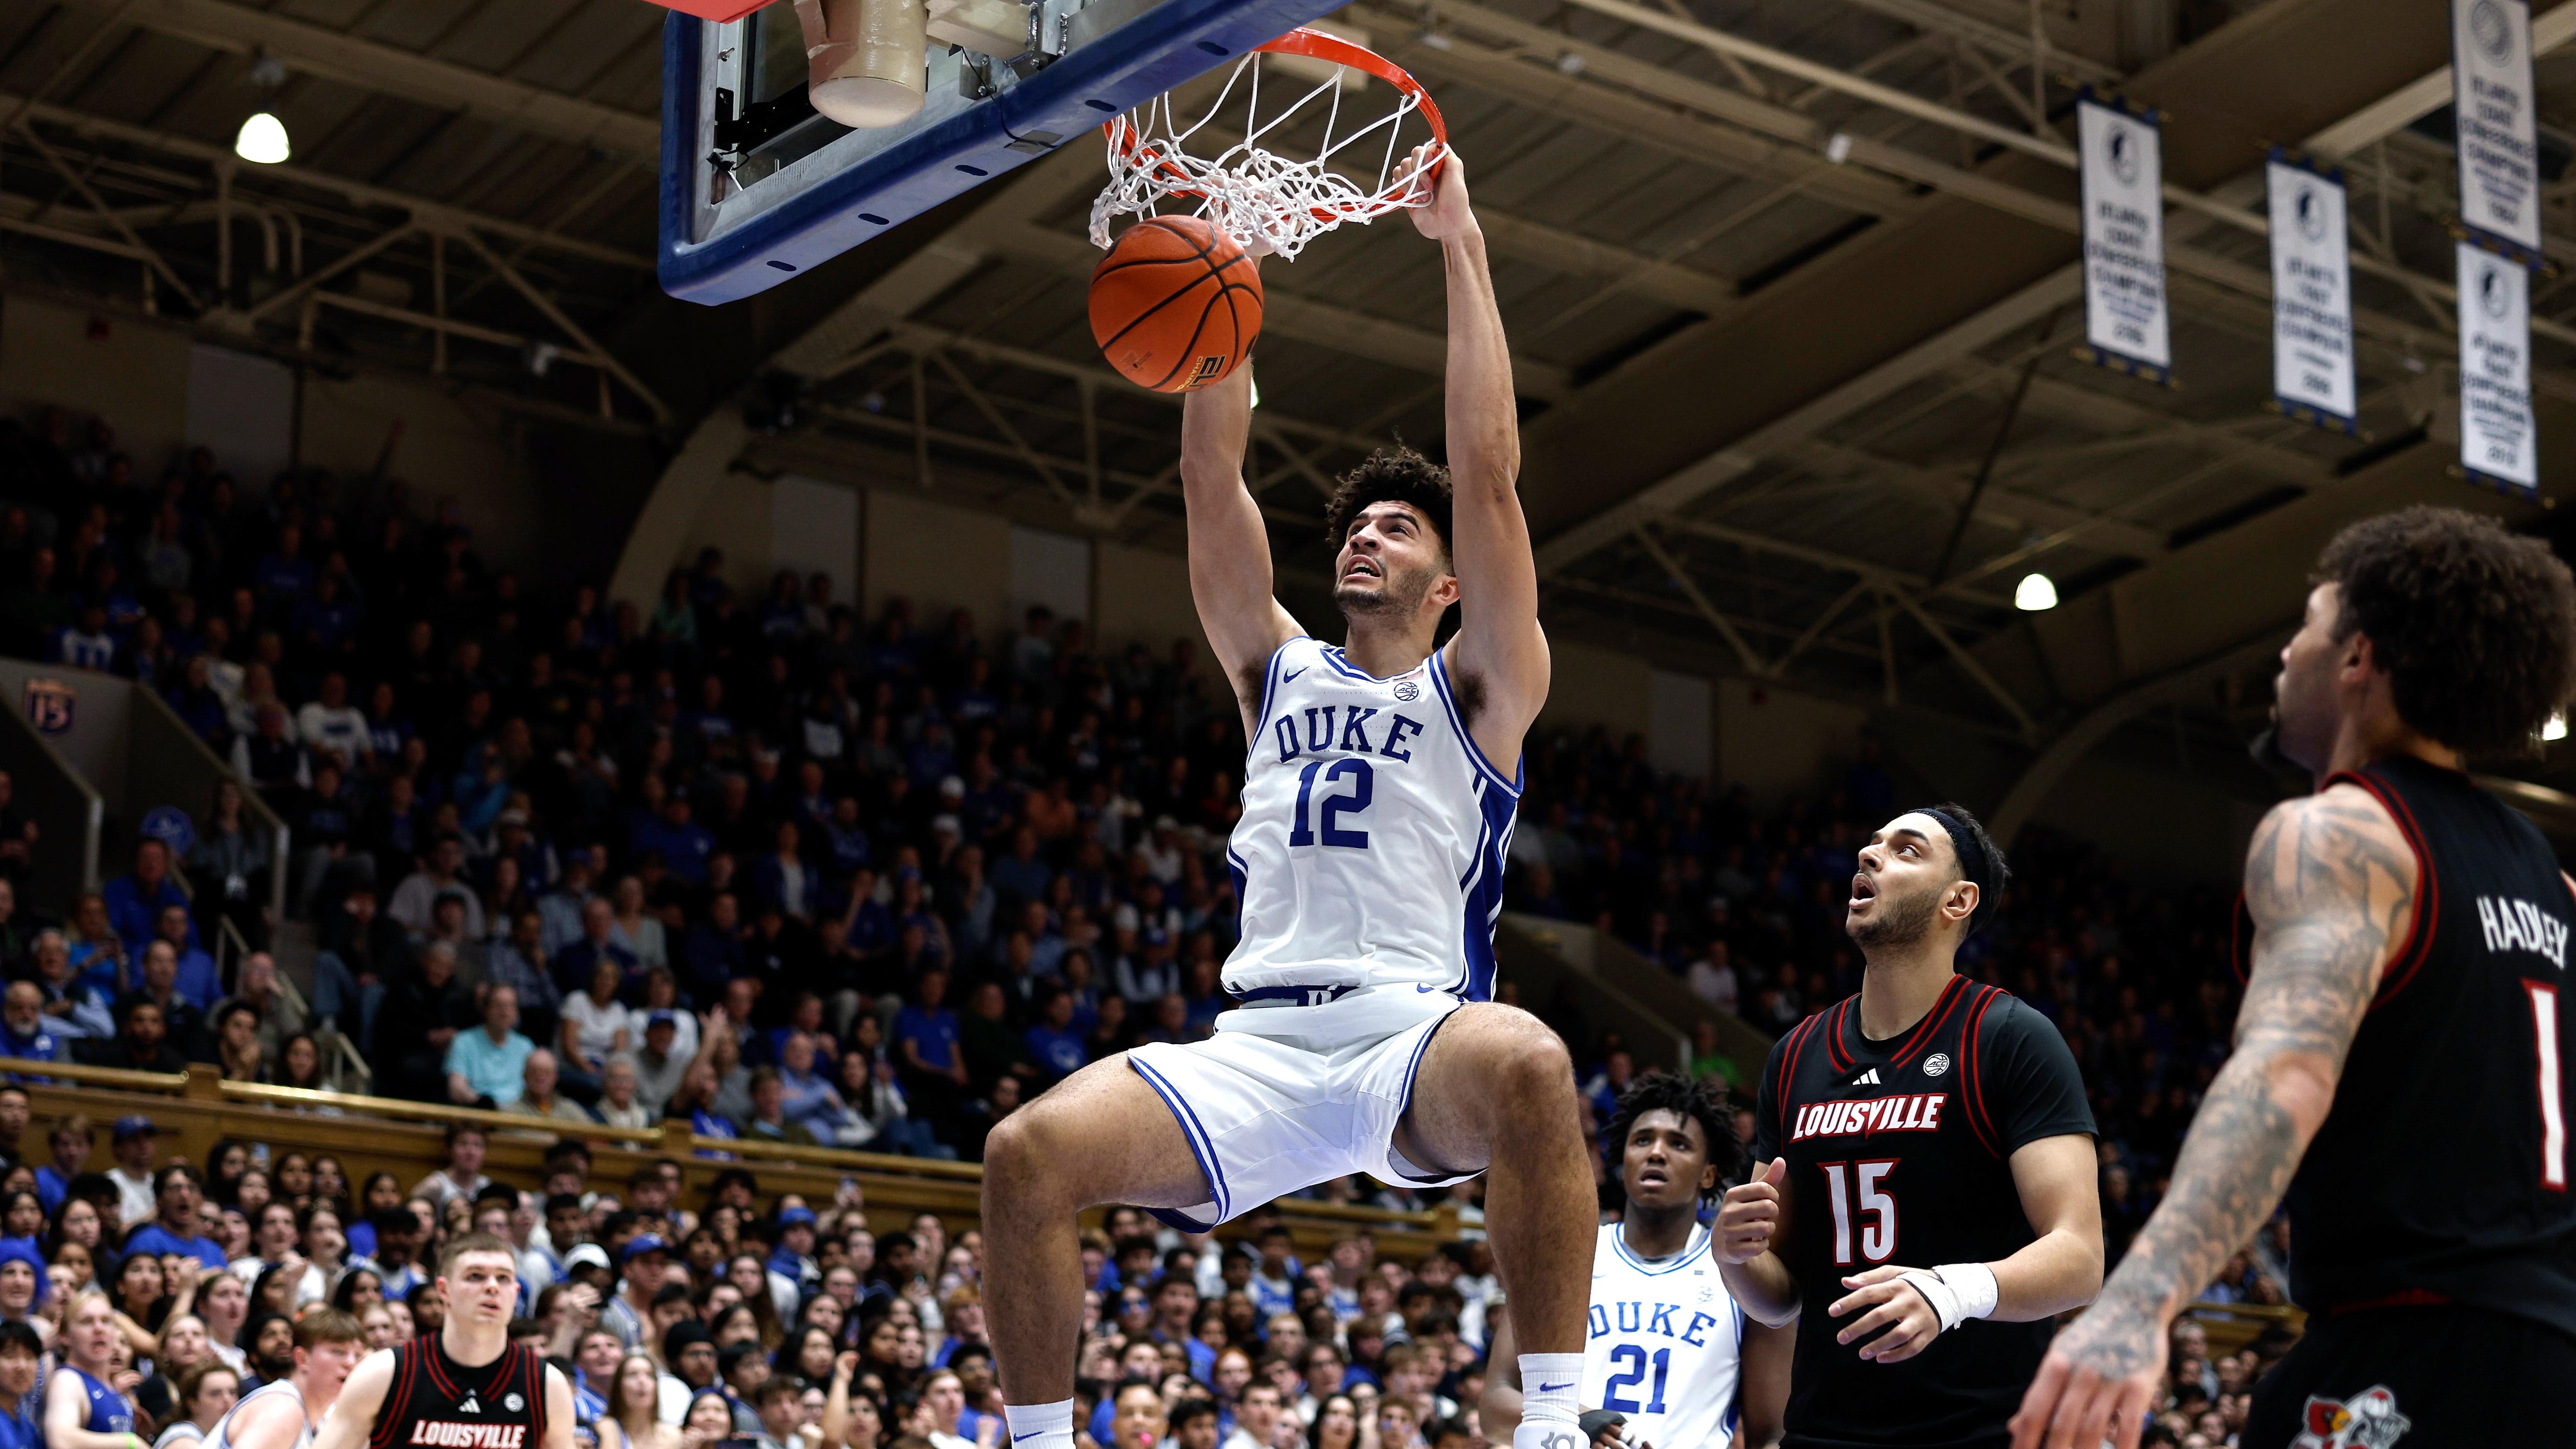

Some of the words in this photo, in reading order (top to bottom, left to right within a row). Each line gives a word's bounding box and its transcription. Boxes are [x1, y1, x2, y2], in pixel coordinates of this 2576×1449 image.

[1275, 706, 1424, 764] DUKE
[1289, 758, 1374, 849] 12
[2476, 895, 2568, 971] HADLEY
[1789, 1093, 1948, 1143] LOUISVILLE
[1816, 1157, 1901, 1267] 15
[1588, 1302, 1717, 1348] DUKE
[1602, 1344, 1671, 1414] 21
[406, 1419, 528, 1449] LOUISVILLE
